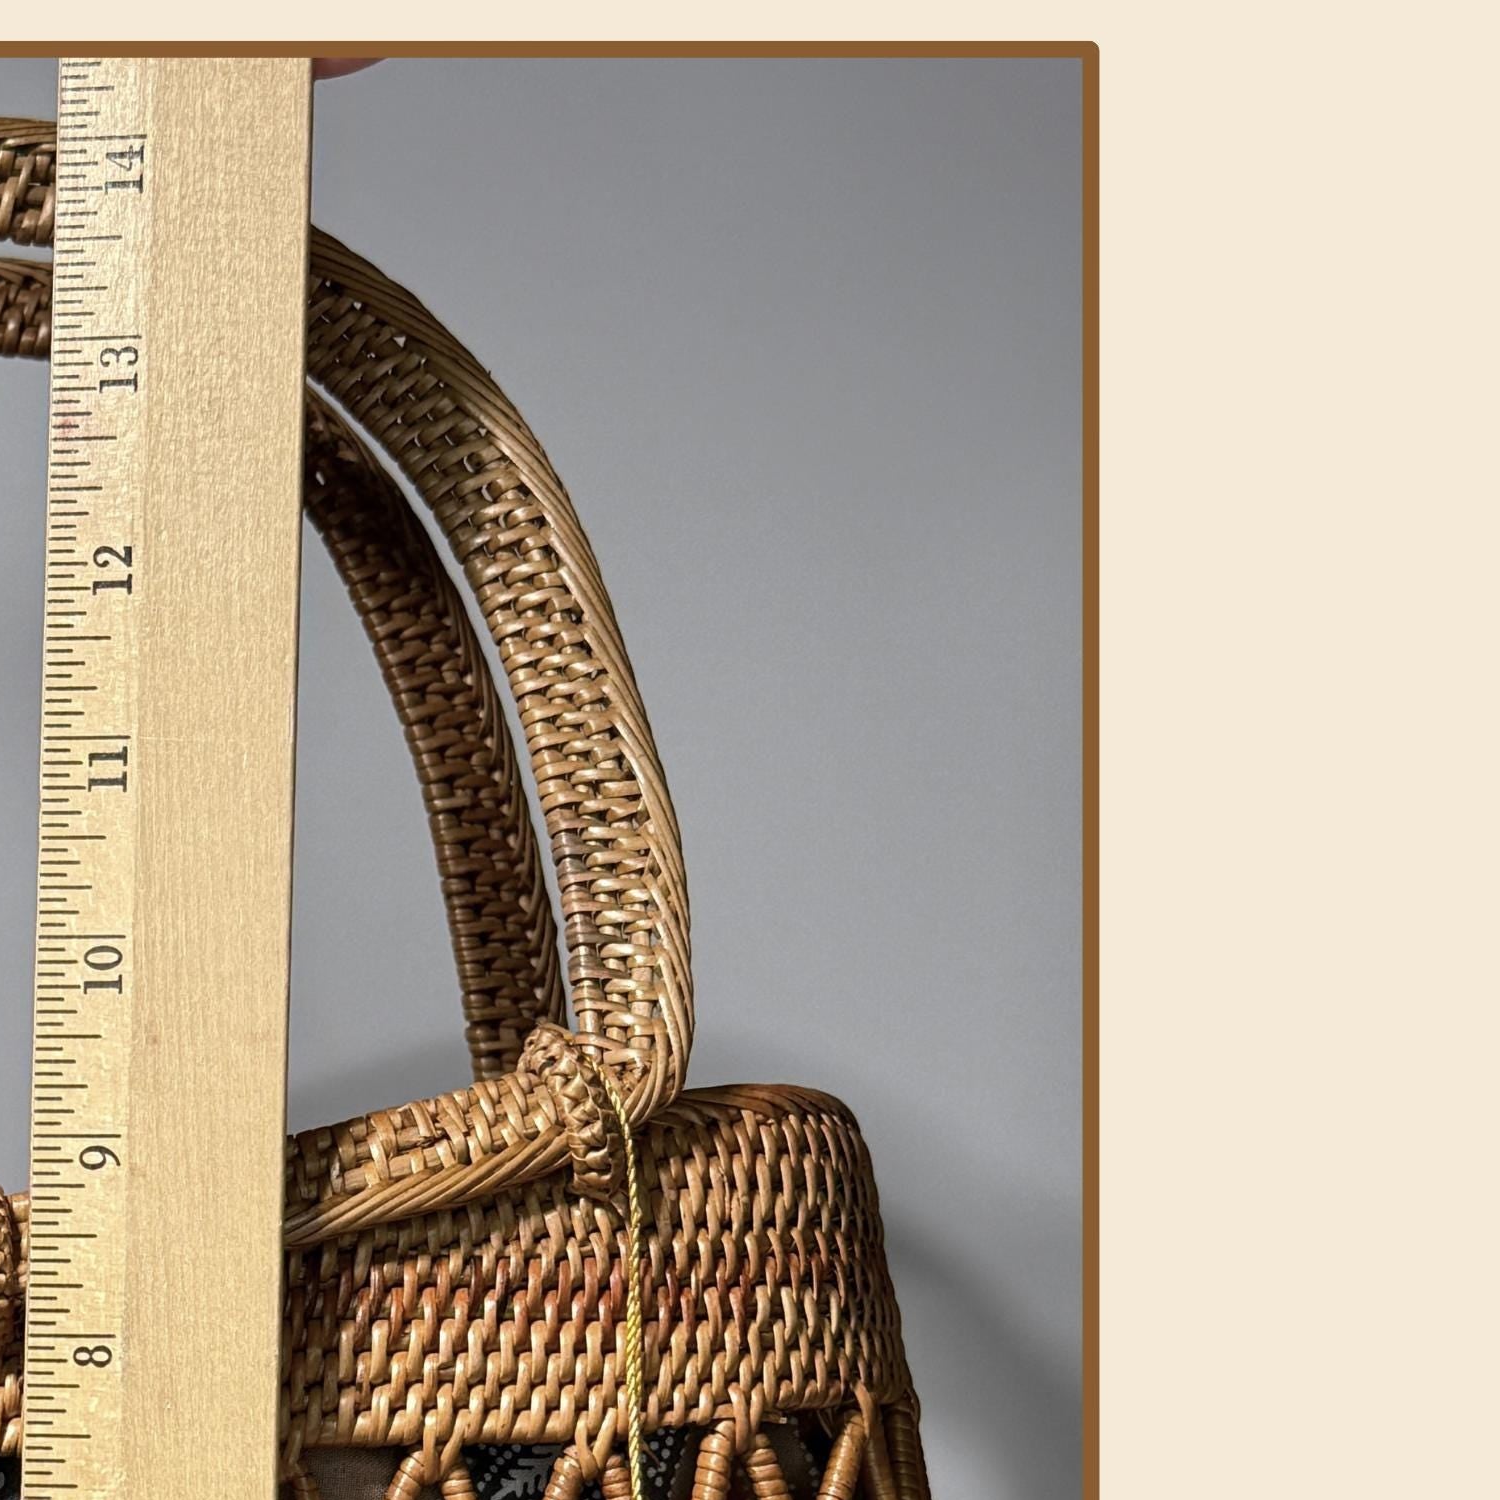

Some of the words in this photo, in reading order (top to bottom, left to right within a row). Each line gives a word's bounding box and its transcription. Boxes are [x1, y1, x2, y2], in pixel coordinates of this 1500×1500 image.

[104, 143, 145, 195] 14
[99, 345, 139, 394] 13
[92, 545, 133, 597] 12
[87, 745, 129, 793] 11
[82, 944, 124, 996] 10
[79, 1145, 122, 1170] 9
[73, 1344, 113, 1369] 8
